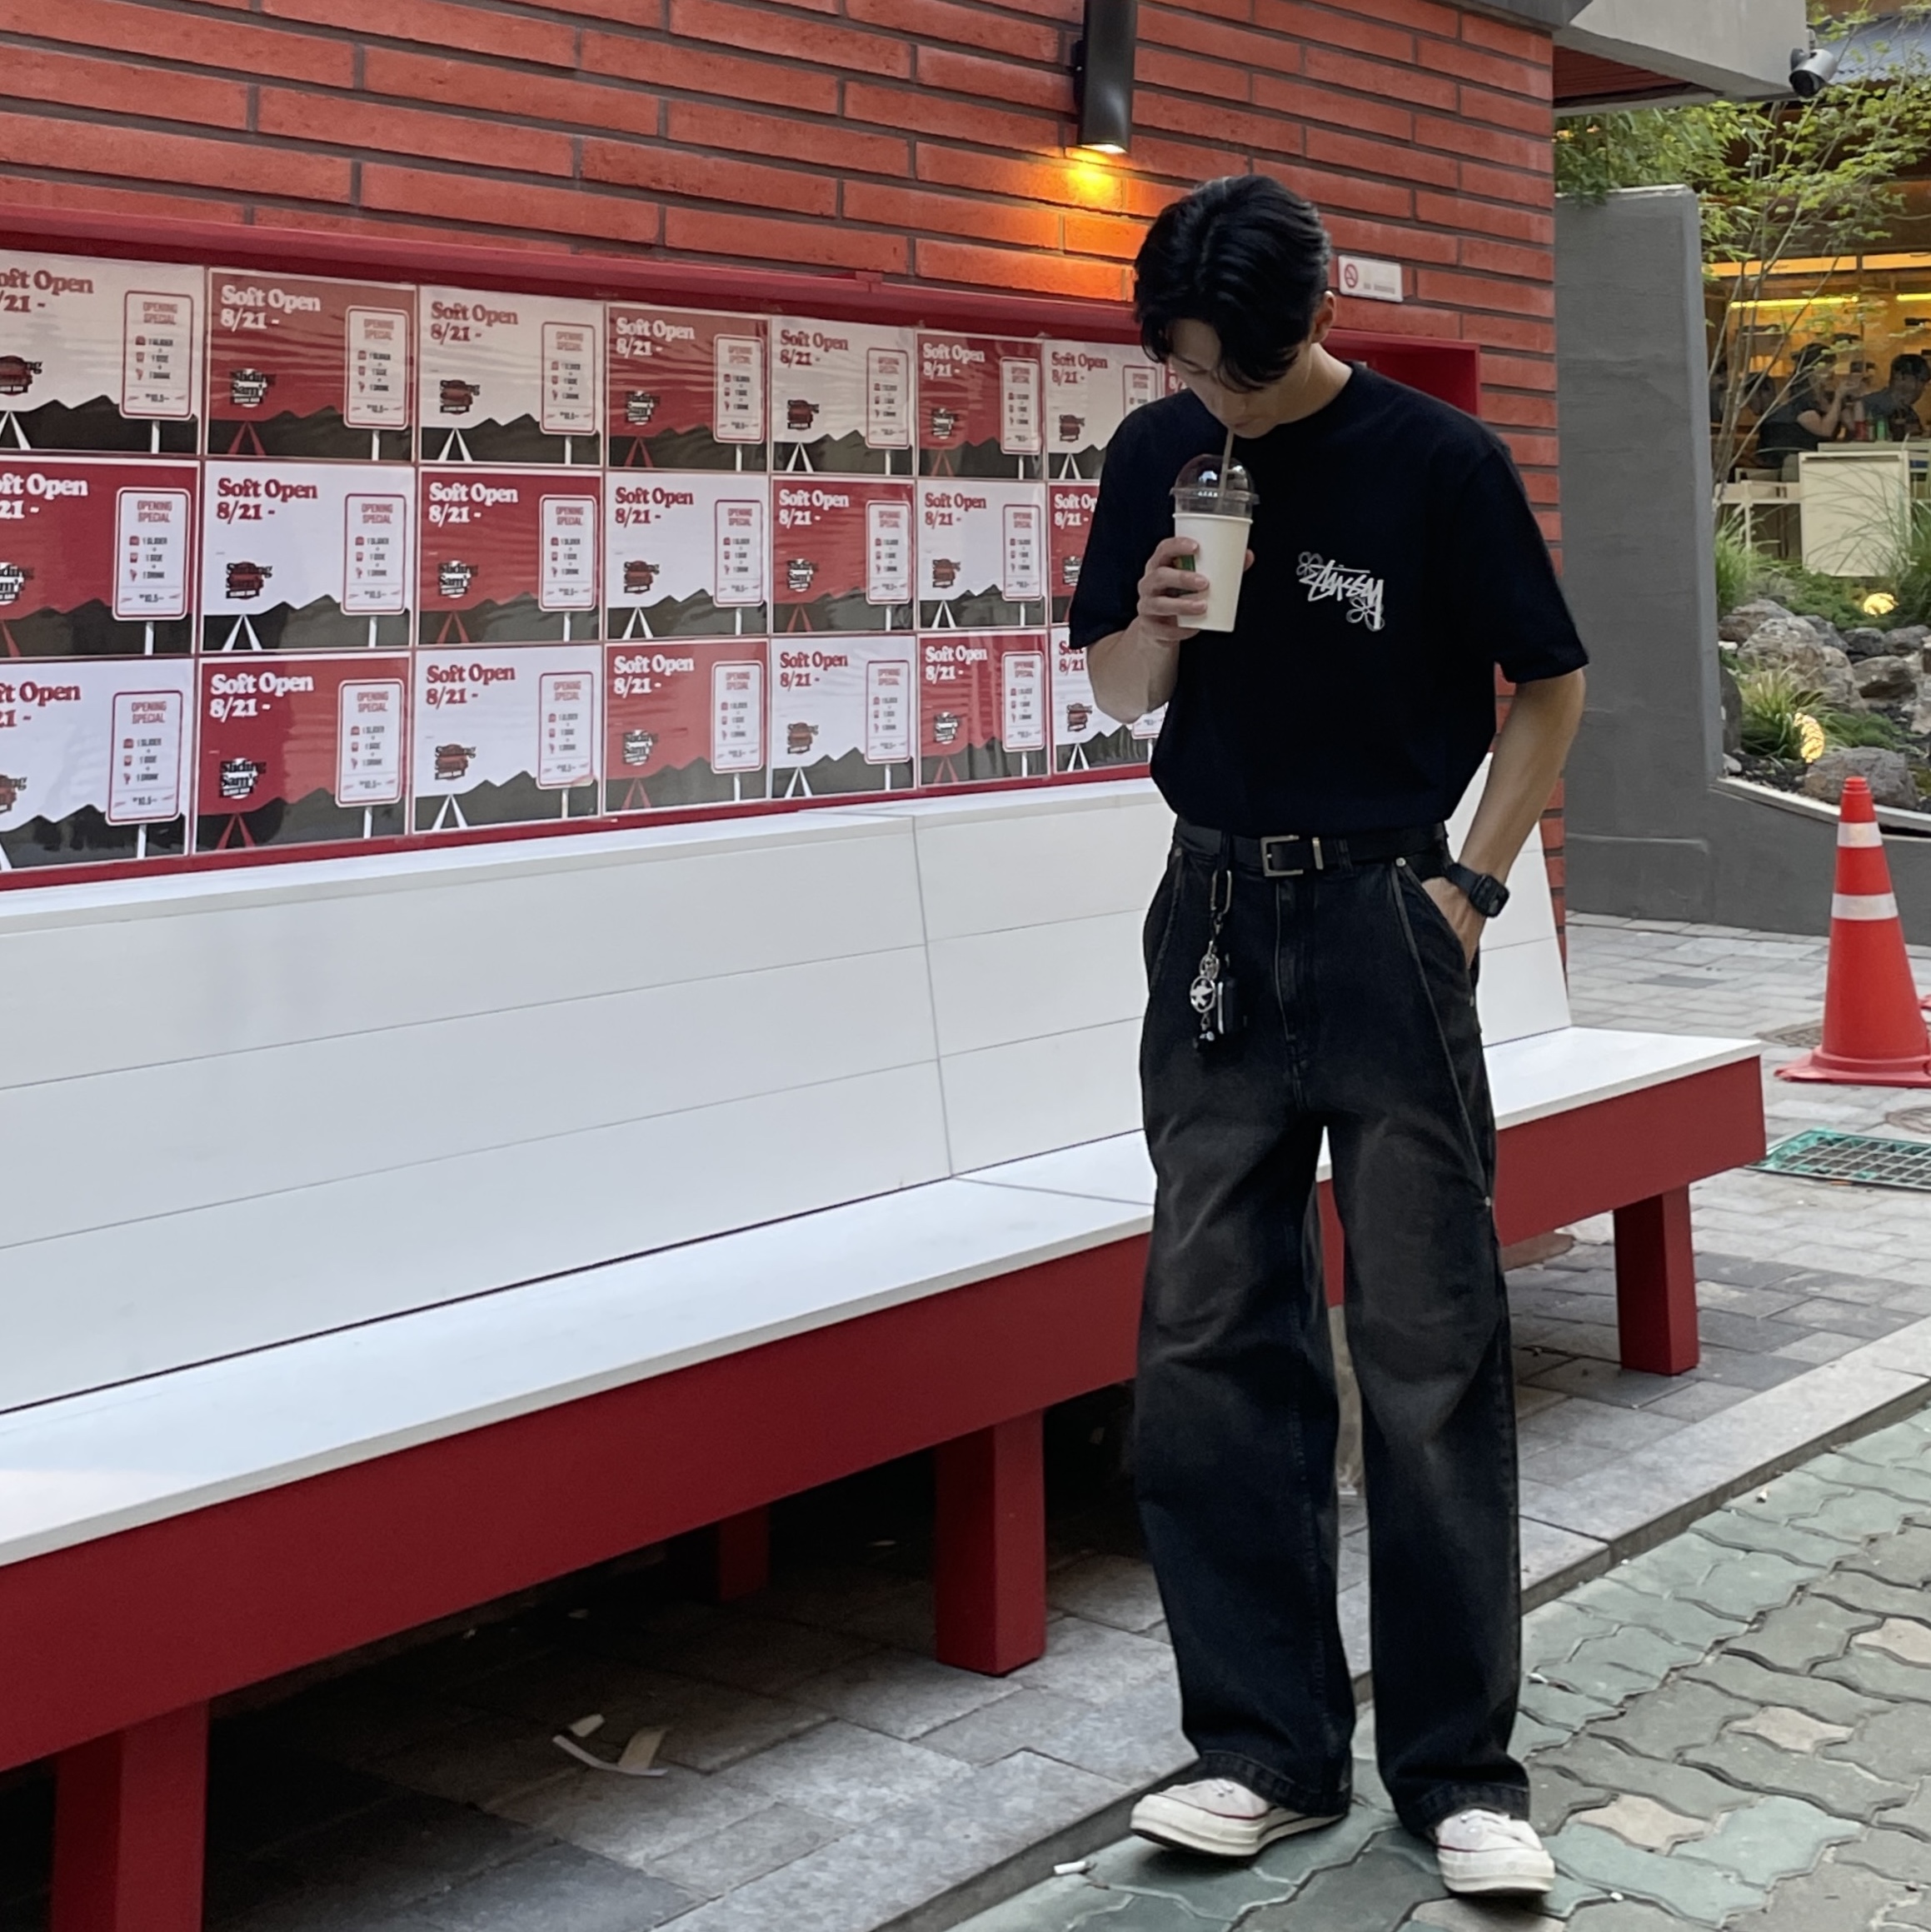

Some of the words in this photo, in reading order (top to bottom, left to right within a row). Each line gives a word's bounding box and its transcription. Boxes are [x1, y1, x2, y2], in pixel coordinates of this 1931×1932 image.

[33, 270, 93, 296] Open
[222, 285, 265, 307] Soft
[268, 289, 320, 313] Open
[221, 308, 267, 332] 8/21
[432, 302, 469, 322] Soft
[472, 305, 518, 327] Open
[431, 322, 470, 345] 8/21
[616, 317, 651, 337] Soft
[653, 320, 695, 342] Open
[616, 337, 651, 358] 8/21
[781, 330, 810, 347] Soft
[813, 332, 848, 352] Open
[780, 348, 812, 367] 8/21
[923, 343, 950, 360] Soft
[951, 345, 985, 365] Open
[1051, 352, 1075, 367] Soft
[1078, 353, 1108, 372] Open
[923, 361, 951, 380] 8/21
[27, 473, 87, 500] Open
[217, 477, 261, 498] Soft
[265, 479, 317, 503] Open
[430, 482, 468, 502] Soft
[471, 483, 518, 506] Open
[616, 487, 650, 504] Soft
[652, 487, 694, 508] Open
[779, 489, 810, 506] Soft
[812, 490, 849, 510] Open
[925, 492, 951, 508] Soft
[954, 493, 986, 512] Open
[1055, 493, 1080, 509] Soft
[1081, 493, 1098, 512] Op
[217, 501, 262, 524] 8/21
[429, 503, 470, 527] 8/21
[616, 507, 651, 527] 8/21
[780, 508, 811, 528] 8/21
[925, 512, 953, 528] 8/21
[615, 656, 650, 673] Soft
[652, 655, 694, 676] Open
[781, 651, 810, 668] Soft
[812, 651, 848, 671] Open
[926, 646, 954, 662] Soft
[956, 646, 987, 666] Open
[211, 673, 257, 695] Soft
[259, 672, 314, 696] Open
[427, 665, 466, 683] Soft
[468, 663, 515, 685] Open
[781, 671, 811, 690] 8/21
[926, 665, 956, 684] 8/21
[19, 681, 81, 706] Open
[427, 686, 467, 709] 8/21
[614, 676, 651, 698] 8/21
[132, 701, 167, 712] OPENING
[210, 696, 257, 722] 8/21
[132, 713, 165, 724] SPECIAL
